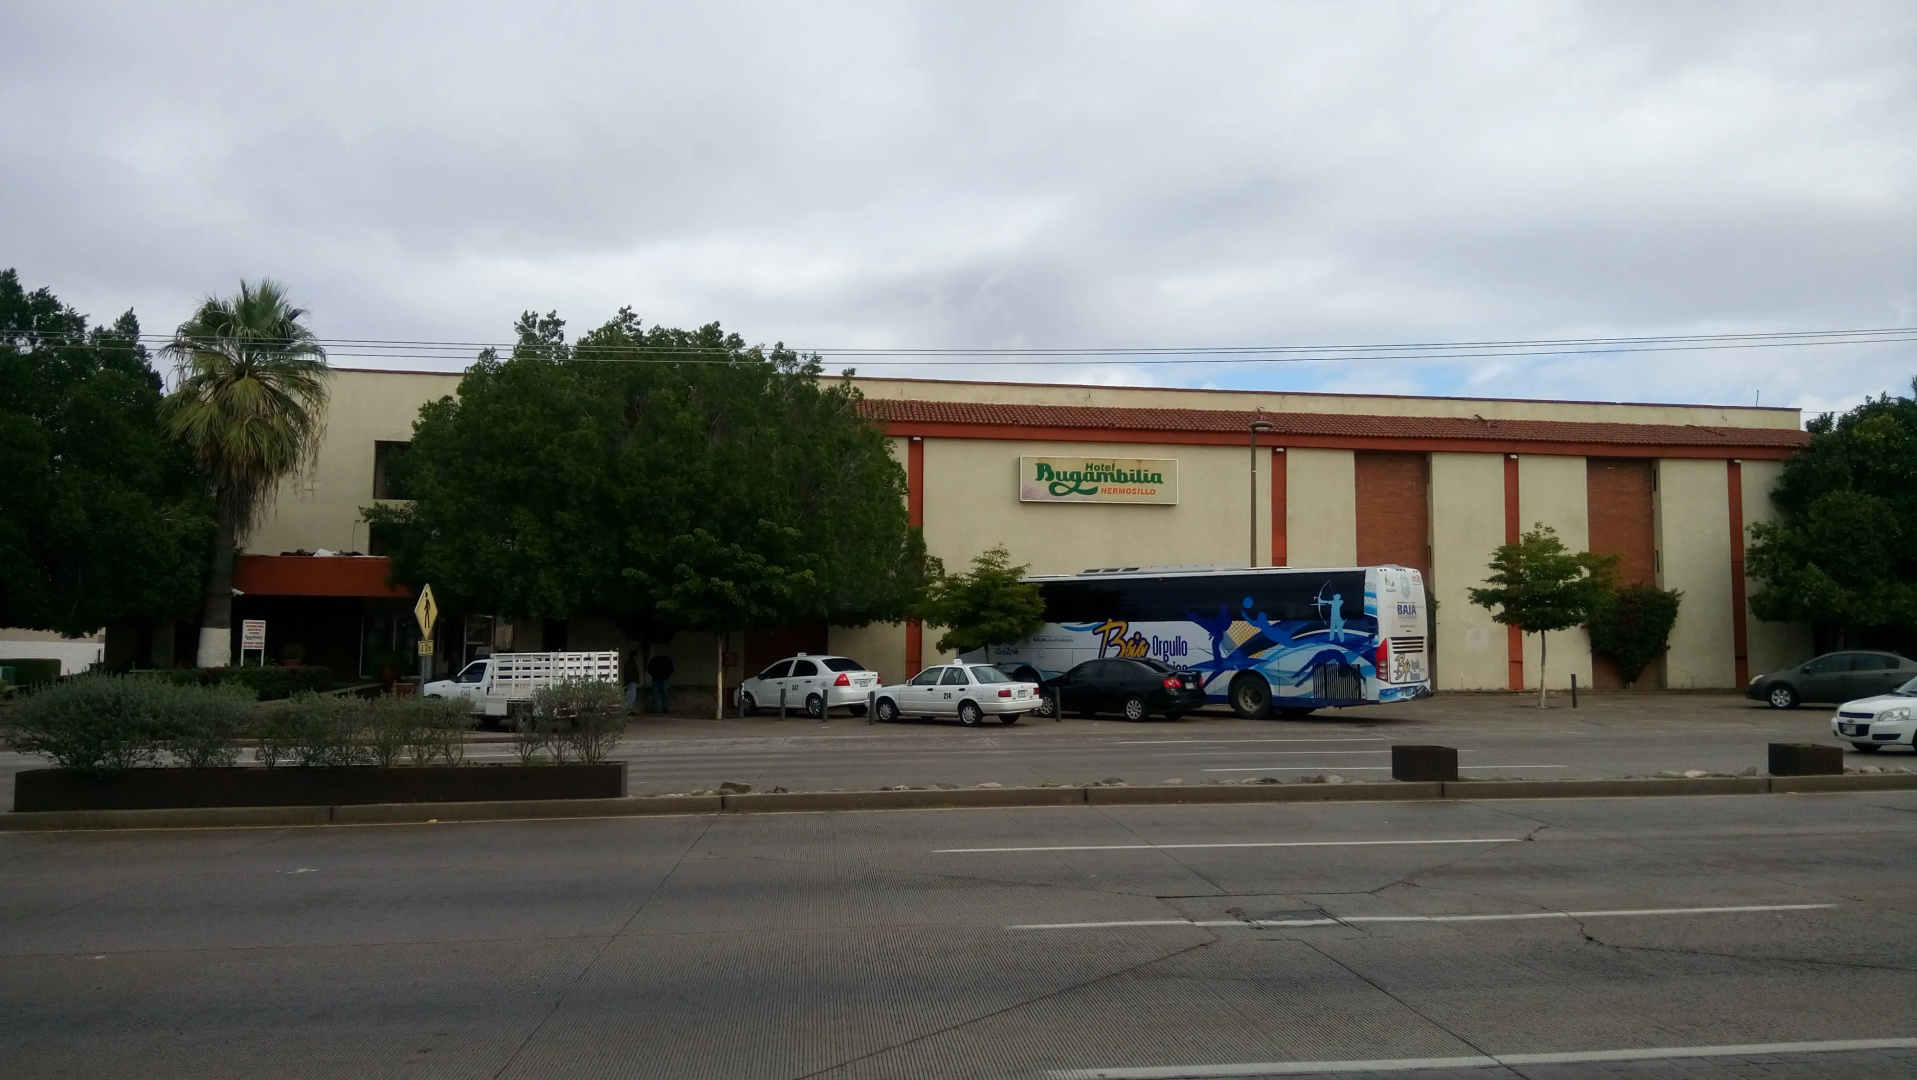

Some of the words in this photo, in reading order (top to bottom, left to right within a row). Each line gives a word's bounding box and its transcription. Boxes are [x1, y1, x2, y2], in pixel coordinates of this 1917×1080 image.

[1085, 463, 1115, 471] Hotel
[1035, 463, 1163, 497] Bugambilia
[1397, 604, 1416, 615] BAJA
[1152, 635, 1187, 662] Orgullo
